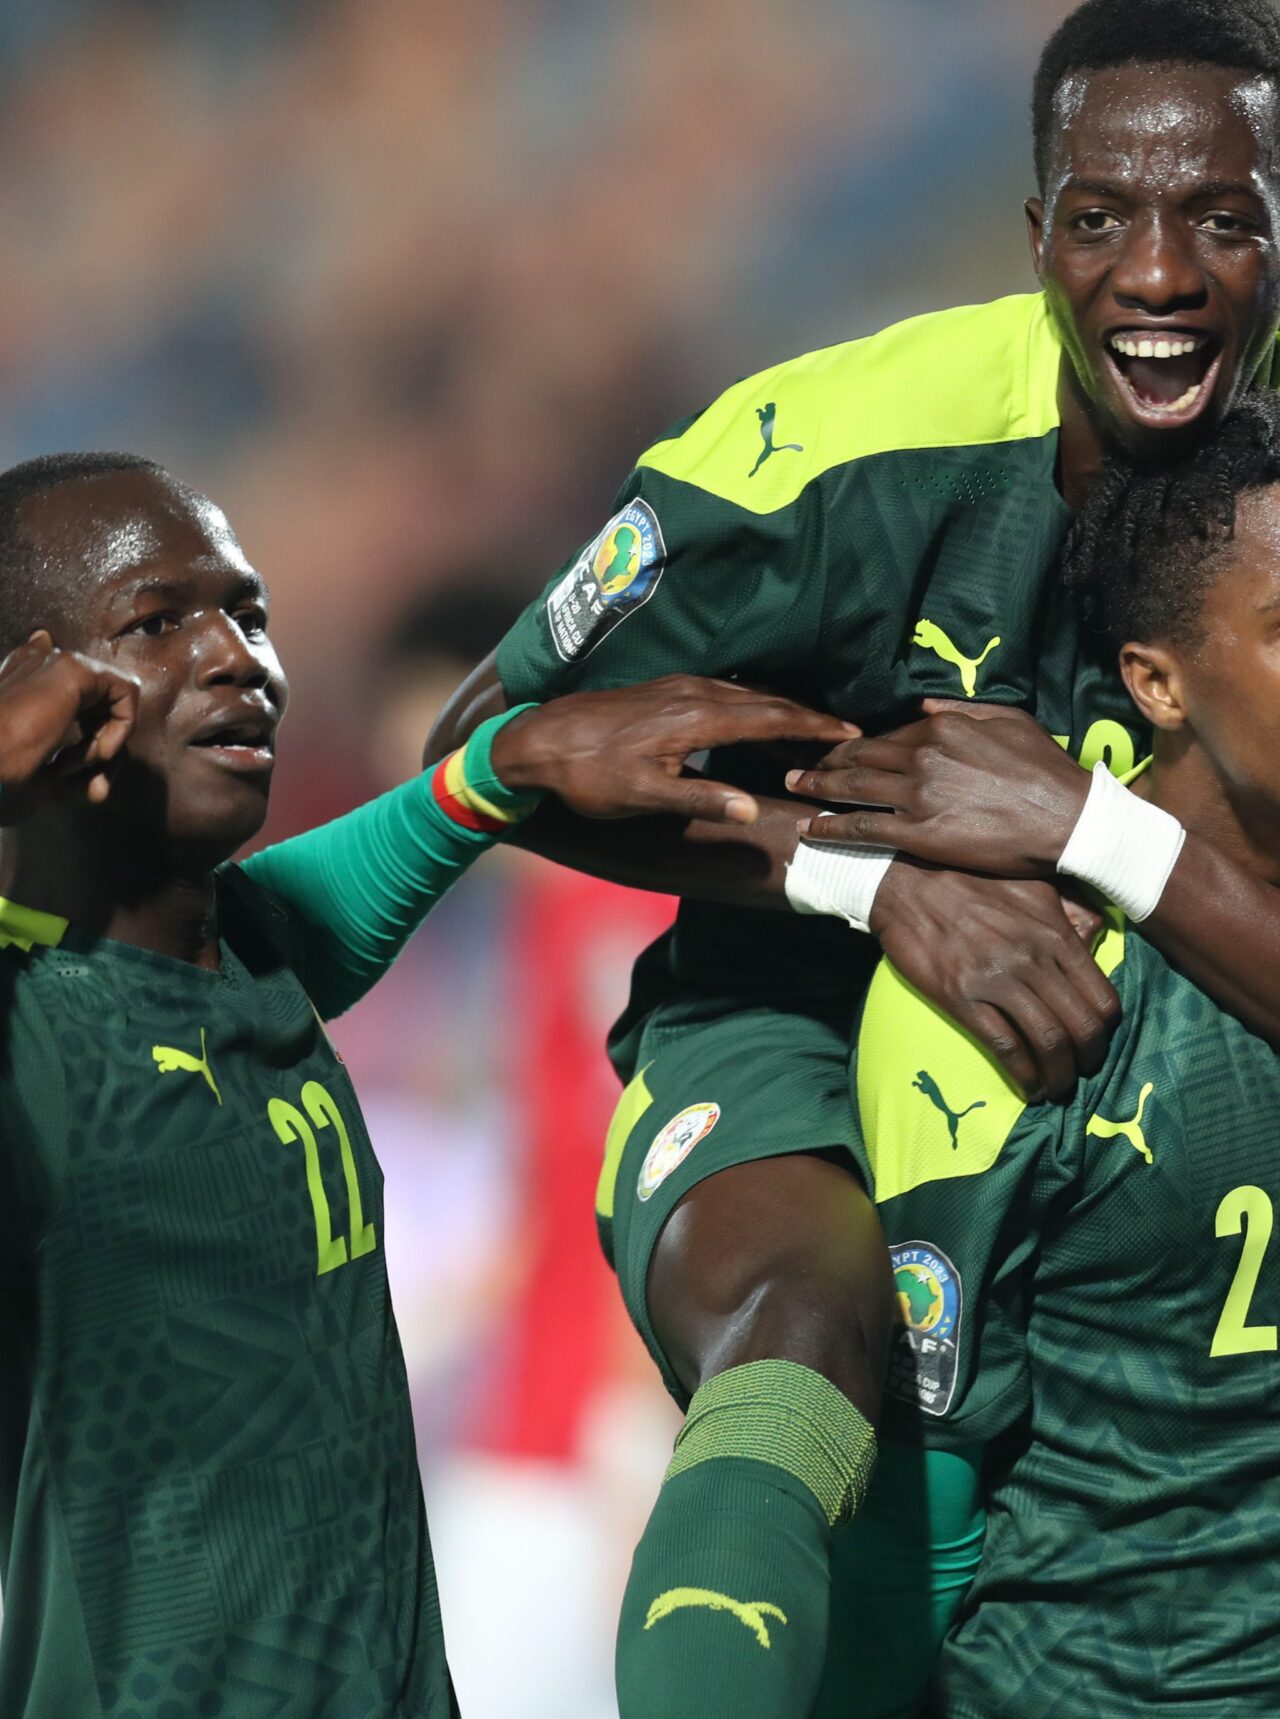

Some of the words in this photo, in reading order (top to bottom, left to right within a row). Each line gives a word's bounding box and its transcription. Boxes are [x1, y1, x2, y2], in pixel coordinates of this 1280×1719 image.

[624, 509, 649, 533] EGYPT
[267, 1080, 377, 1276] 22
[891, 1251, 920, 1268] YPT
[922, 1253, 949, 1284] 2023
